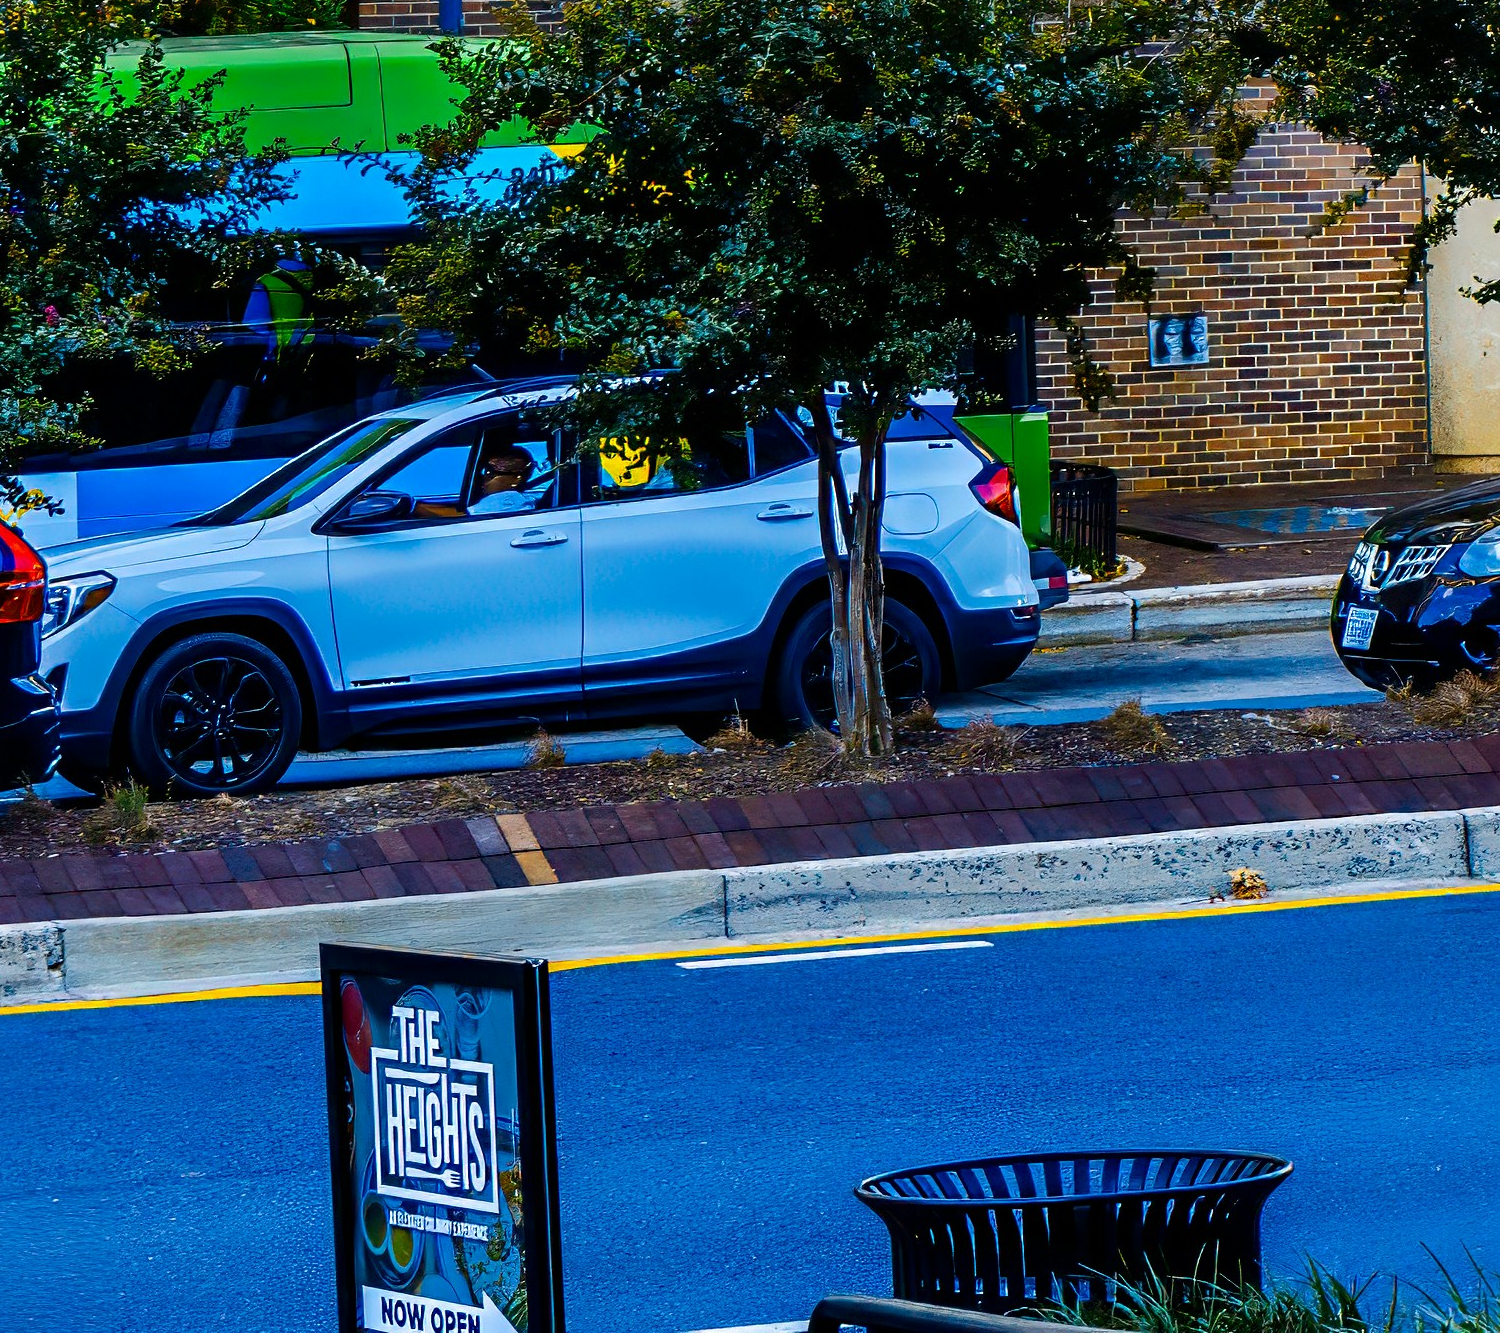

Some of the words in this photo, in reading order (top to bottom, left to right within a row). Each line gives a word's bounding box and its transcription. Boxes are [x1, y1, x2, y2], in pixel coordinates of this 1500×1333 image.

[392, 1005, 446, 1068] THE
[385, 1073, 486, 1192] HEIGHTS
[381, 1296, 426, 1331] NOW
[430, 1307, 480, 1333] OPEN
